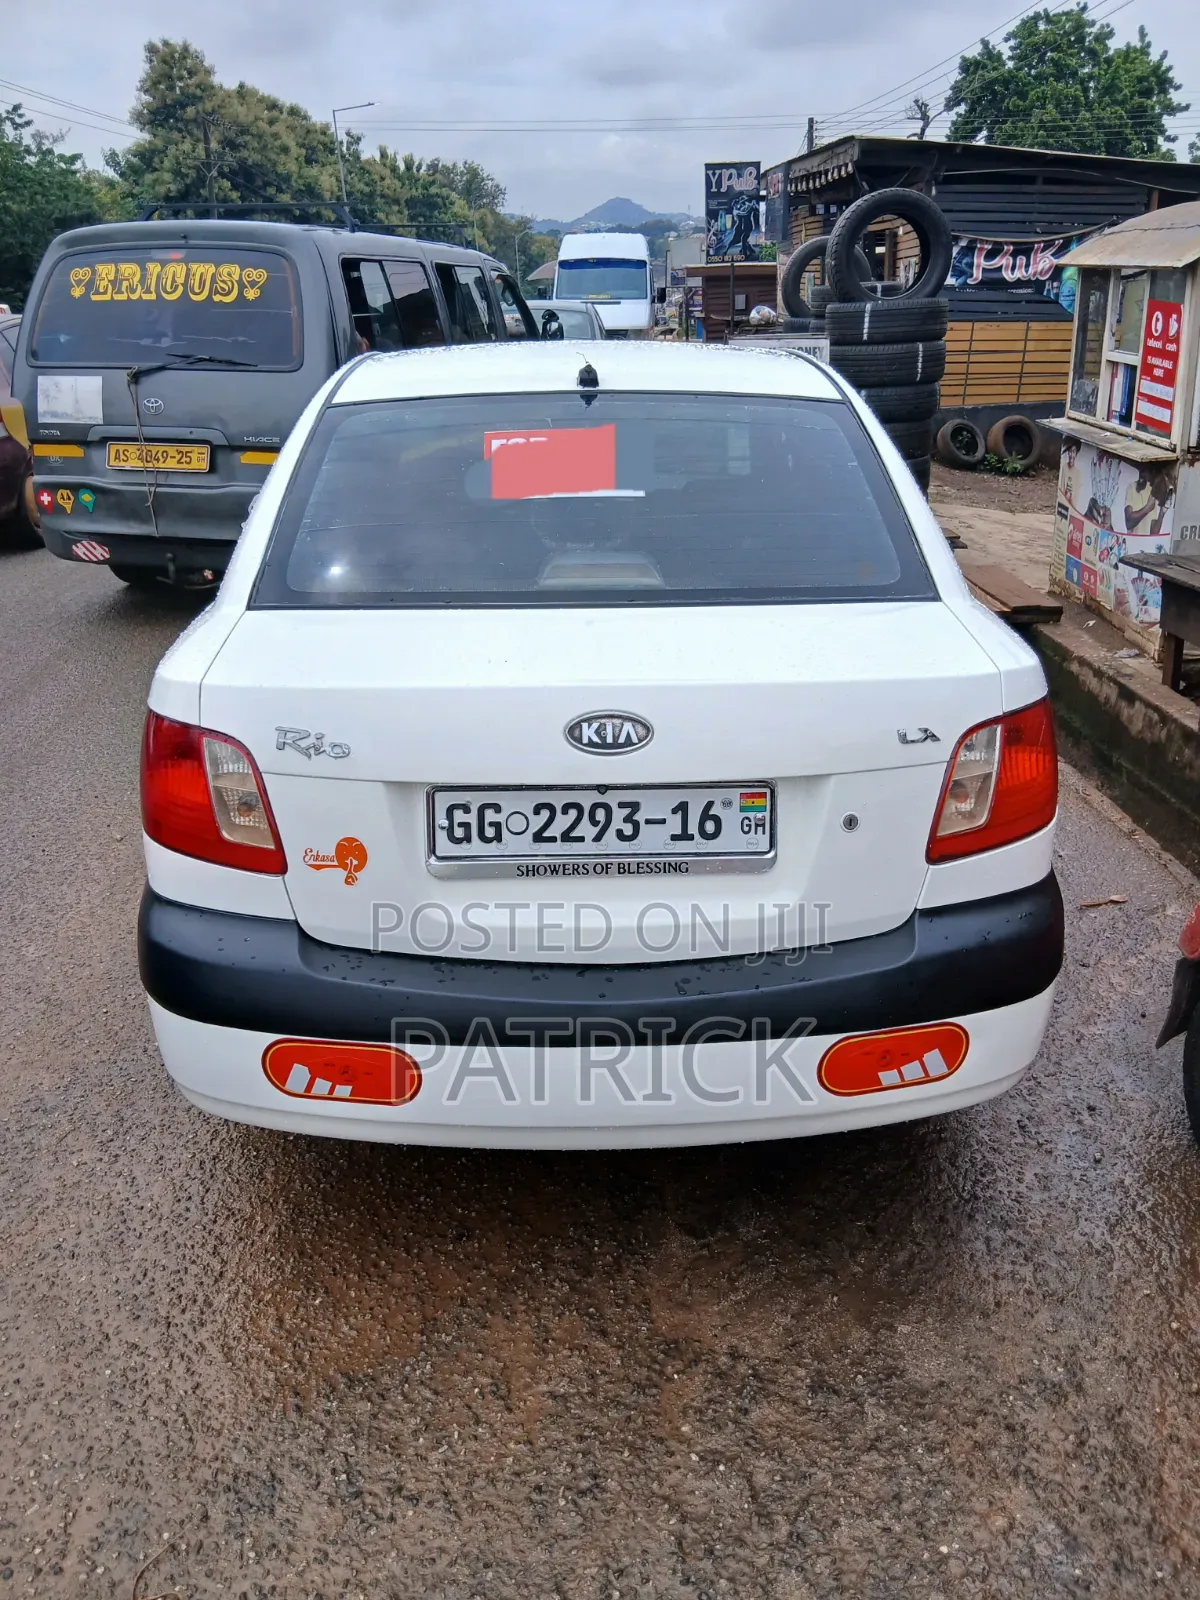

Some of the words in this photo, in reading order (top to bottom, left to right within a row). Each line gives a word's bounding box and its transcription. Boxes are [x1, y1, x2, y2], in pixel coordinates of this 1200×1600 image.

[90, 262, 241, 303] ERICUS
[59, 491, 72, 502] AA
[275, 726, 351, 761] Rio
[580, 721, 639, 744] KIA
[740, 813, 766, 836] GH
[516, 863, 590, 877] SHOWERS
[593, 862, 613, 875] OF
[617, 861, 690, 875] BLESSING
